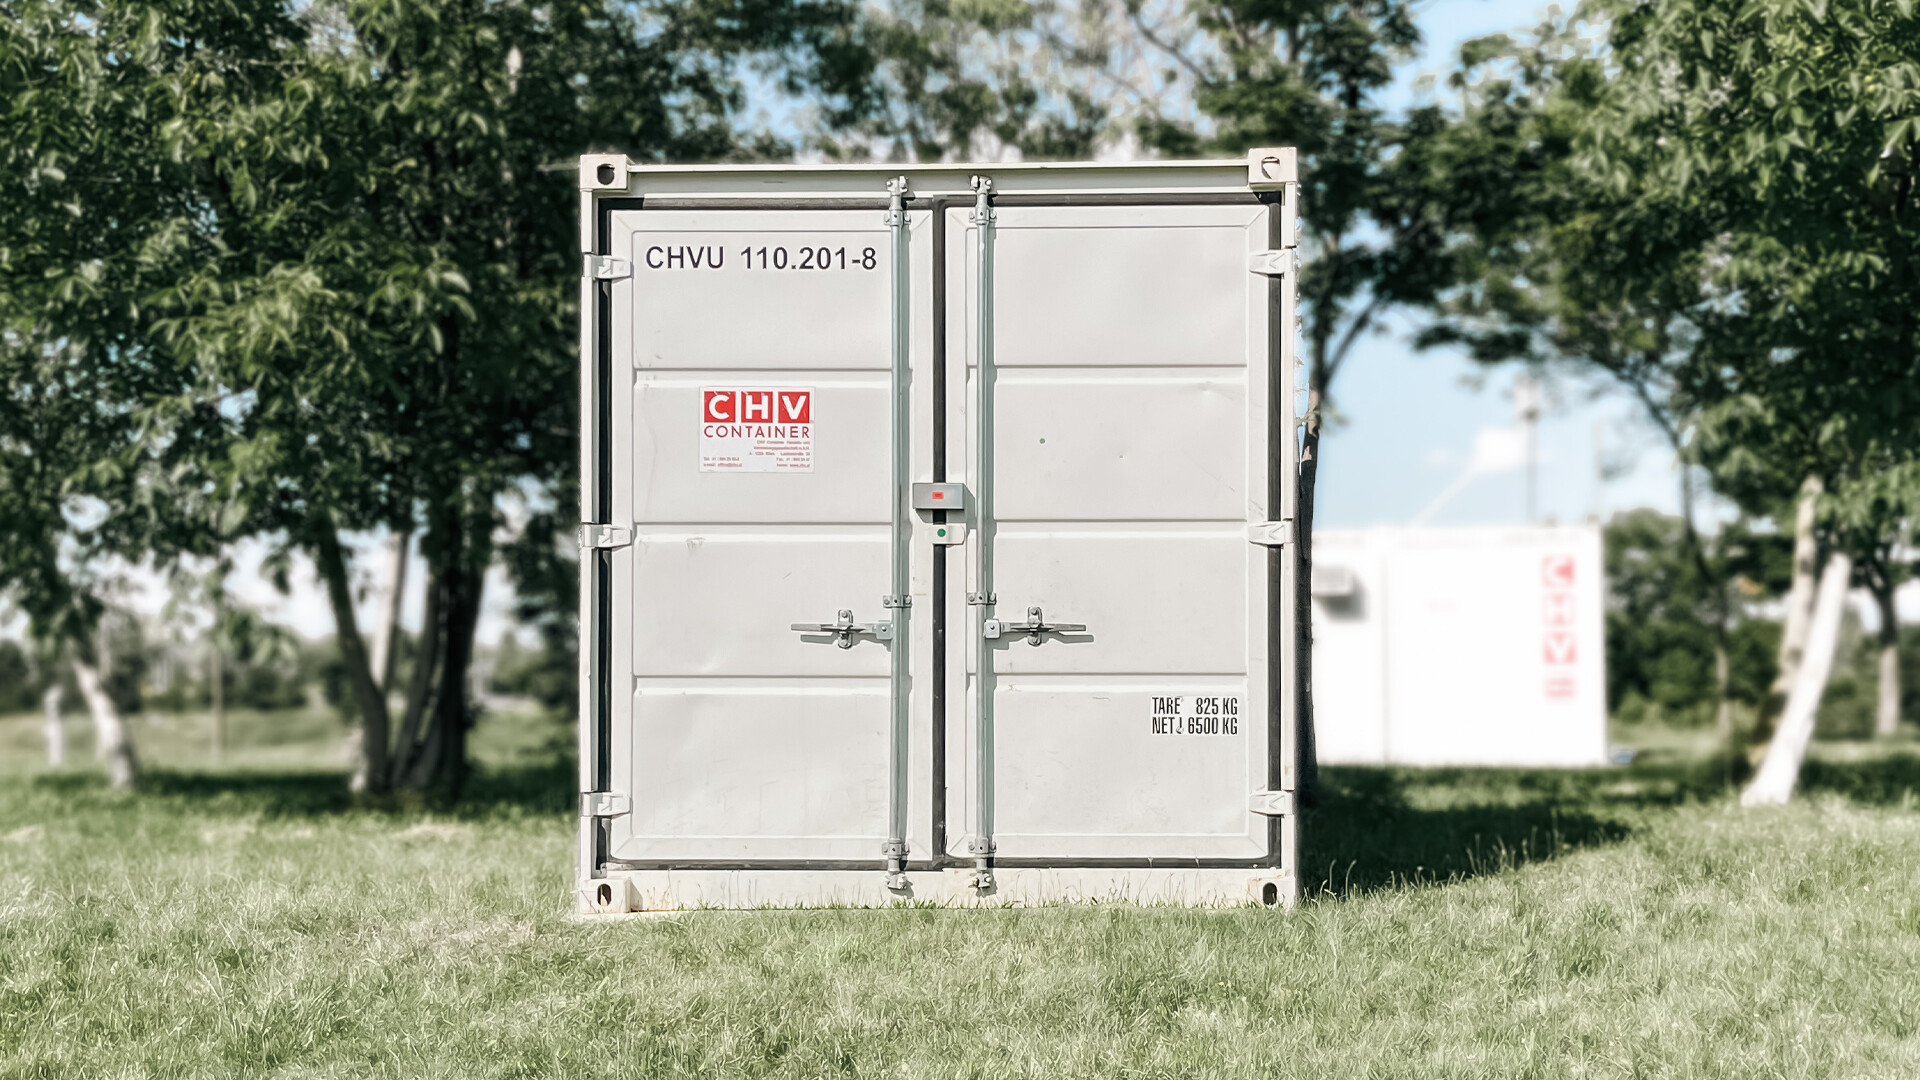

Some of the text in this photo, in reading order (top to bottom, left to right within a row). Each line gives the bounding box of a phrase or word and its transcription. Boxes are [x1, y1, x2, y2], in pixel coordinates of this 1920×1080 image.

[645, 245, 877, 270] CHVU 110.201-8
[708, 393, 807, 421] CHV
[703, 425, 810, 439] CONTAINER
[1151, 697, 1238, 715] TARE 825 KG
[1187, 716, 1219, 735] 6500
[1222, 716, 1238, 735] KG
